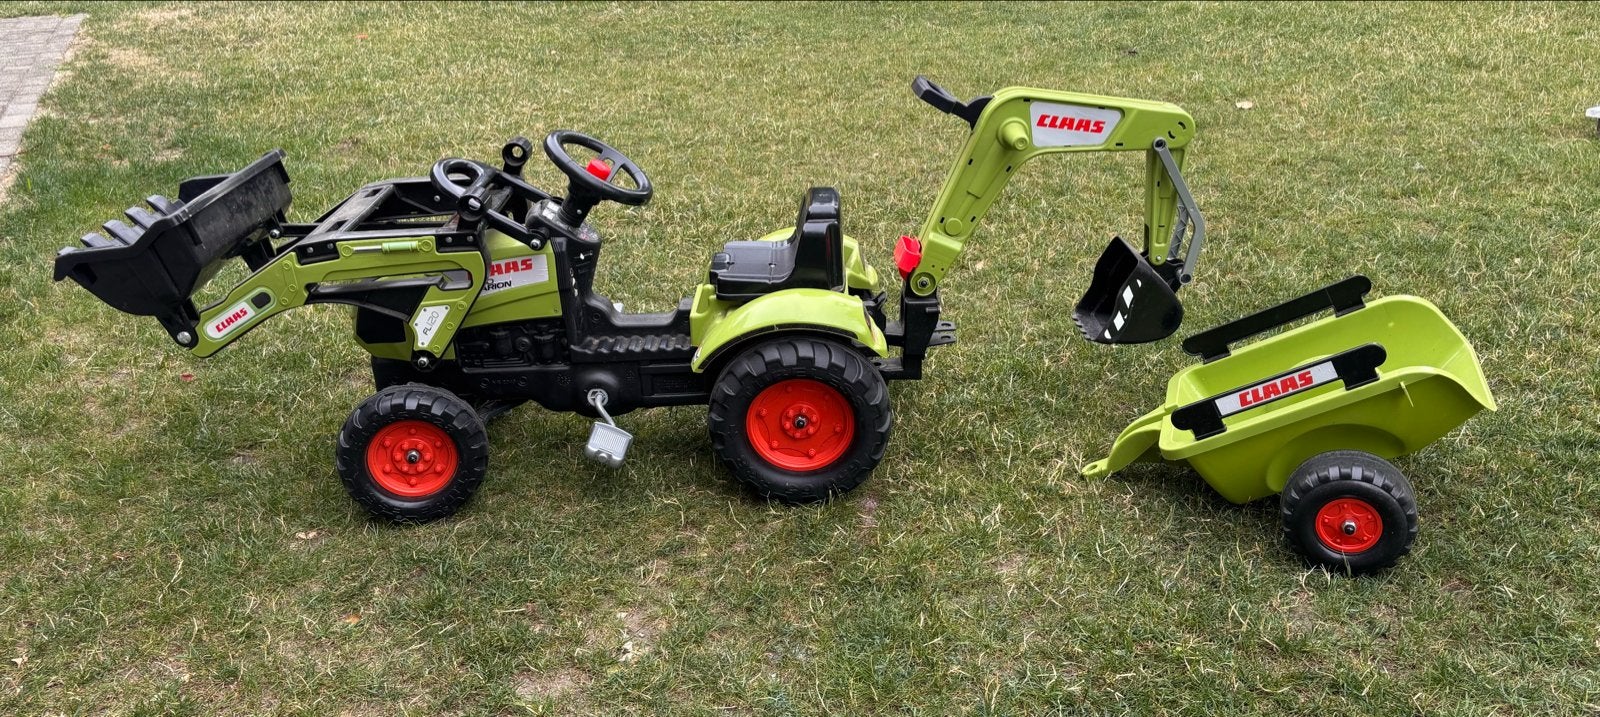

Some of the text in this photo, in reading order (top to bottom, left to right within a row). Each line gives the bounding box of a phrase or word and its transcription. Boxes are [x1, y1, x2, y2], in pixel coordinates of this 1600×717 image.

[1036, 114, 1105, 134] CLAAS
[215, 307, 248, 333] CLAAS
[1238, 370, 1314, 408] CLAAS
